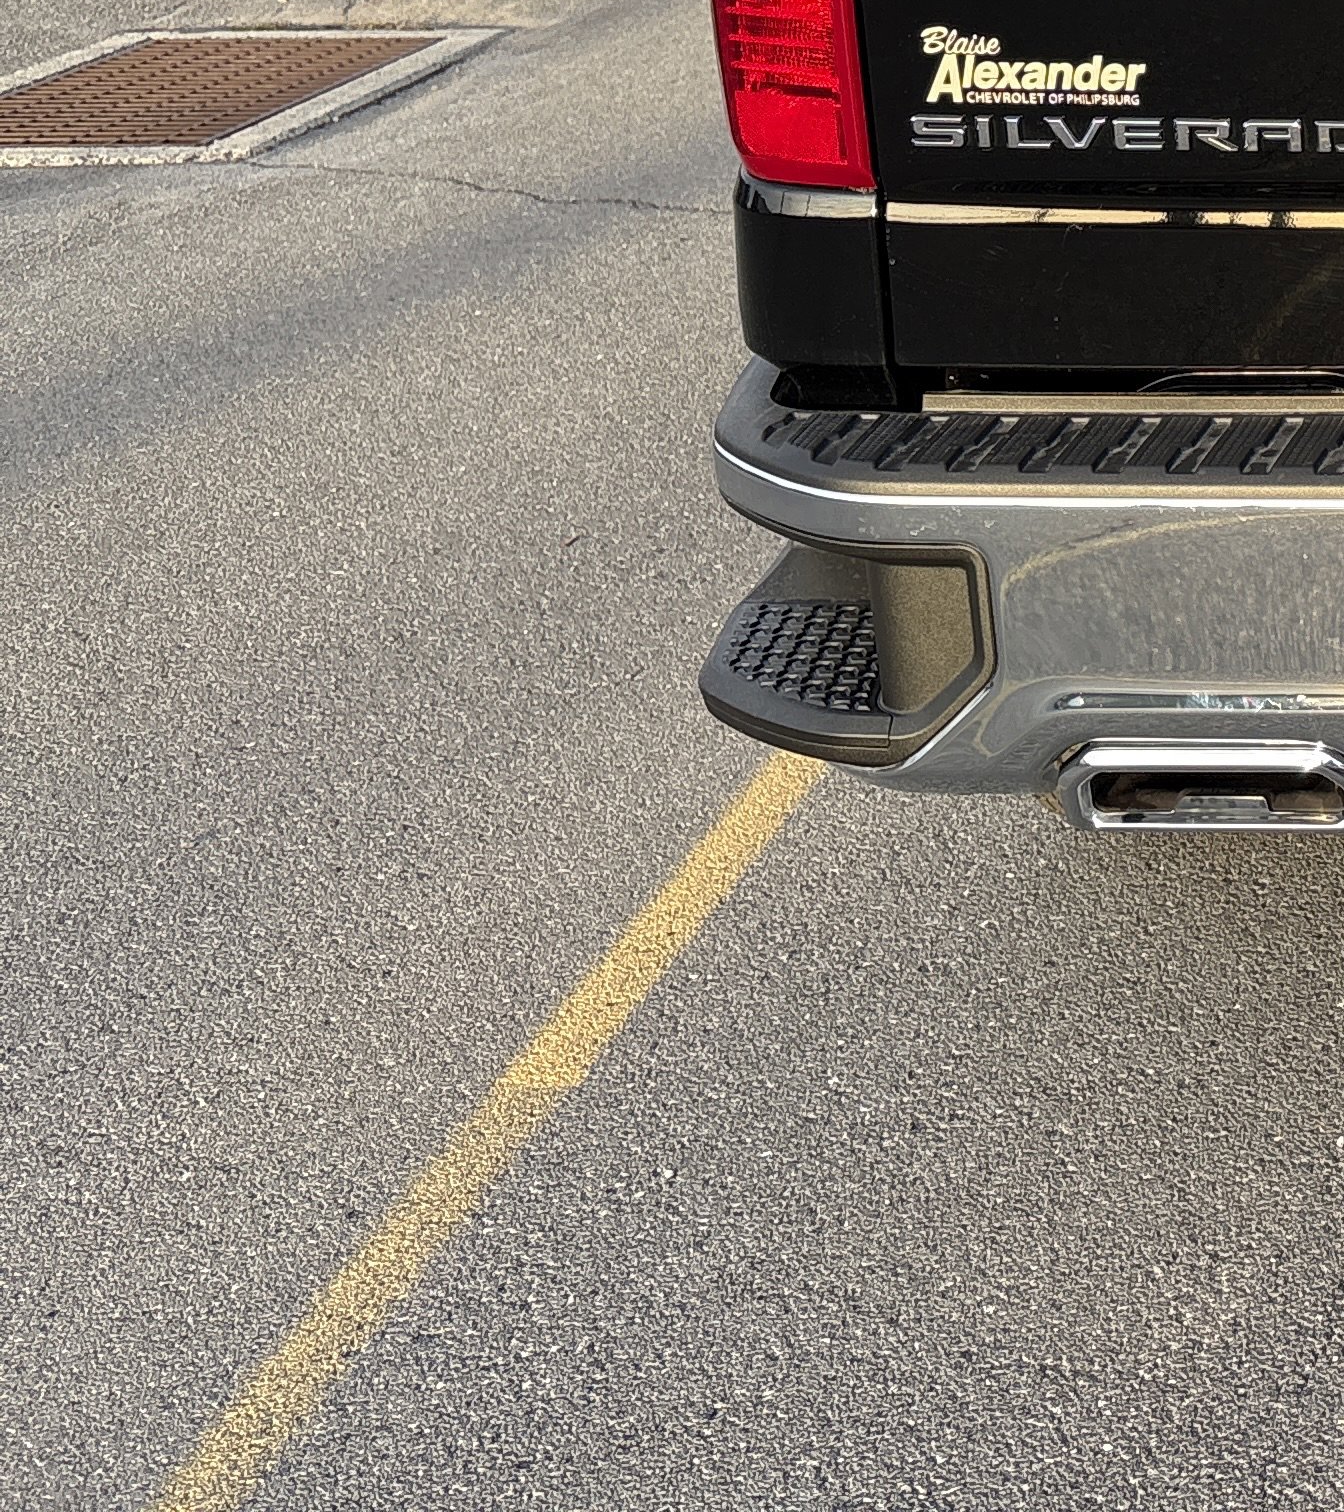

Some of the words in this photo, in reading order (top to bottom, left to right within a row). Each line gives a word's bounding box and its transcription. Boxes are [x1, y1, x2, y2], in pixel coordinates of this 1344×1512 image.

[920, 26, 1001, 55] Blaise
[926, 54, 1147, 103] Alexander
[966, 91, 1045, 105] CHEVROLET
[1048, 93, 1064, 105] OF
[1066, 93, 1141, 106] PHILIPSBURG
